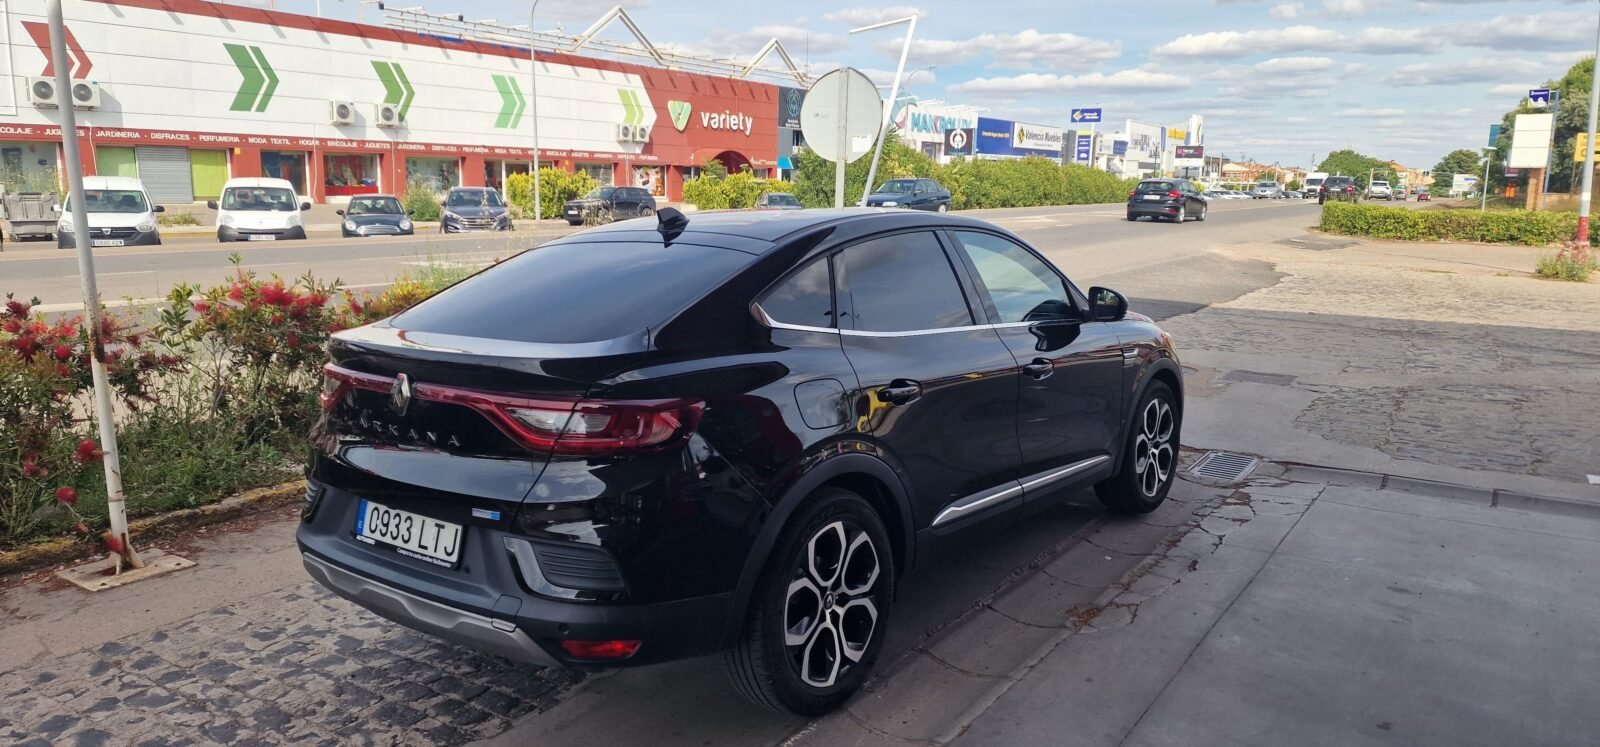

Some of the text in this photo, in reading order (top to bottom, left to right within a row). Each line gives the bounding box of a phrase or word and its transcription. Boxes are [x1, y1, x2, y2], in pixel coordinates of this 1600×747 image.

[700, 110, 753, 136] variety
[150, 132, 190, 140] DISFRACES
[199, 134, 240, 143] PERFUMERIA
[248, 136, 267, 144] MODA
[270, 137, 291, 145] TEXTIL
[327, 140, 358, 148] BRICOLAJE
[360, 417, 461, 446] ARKANA
[368, 506, 459, 557] 0933 LTJ
